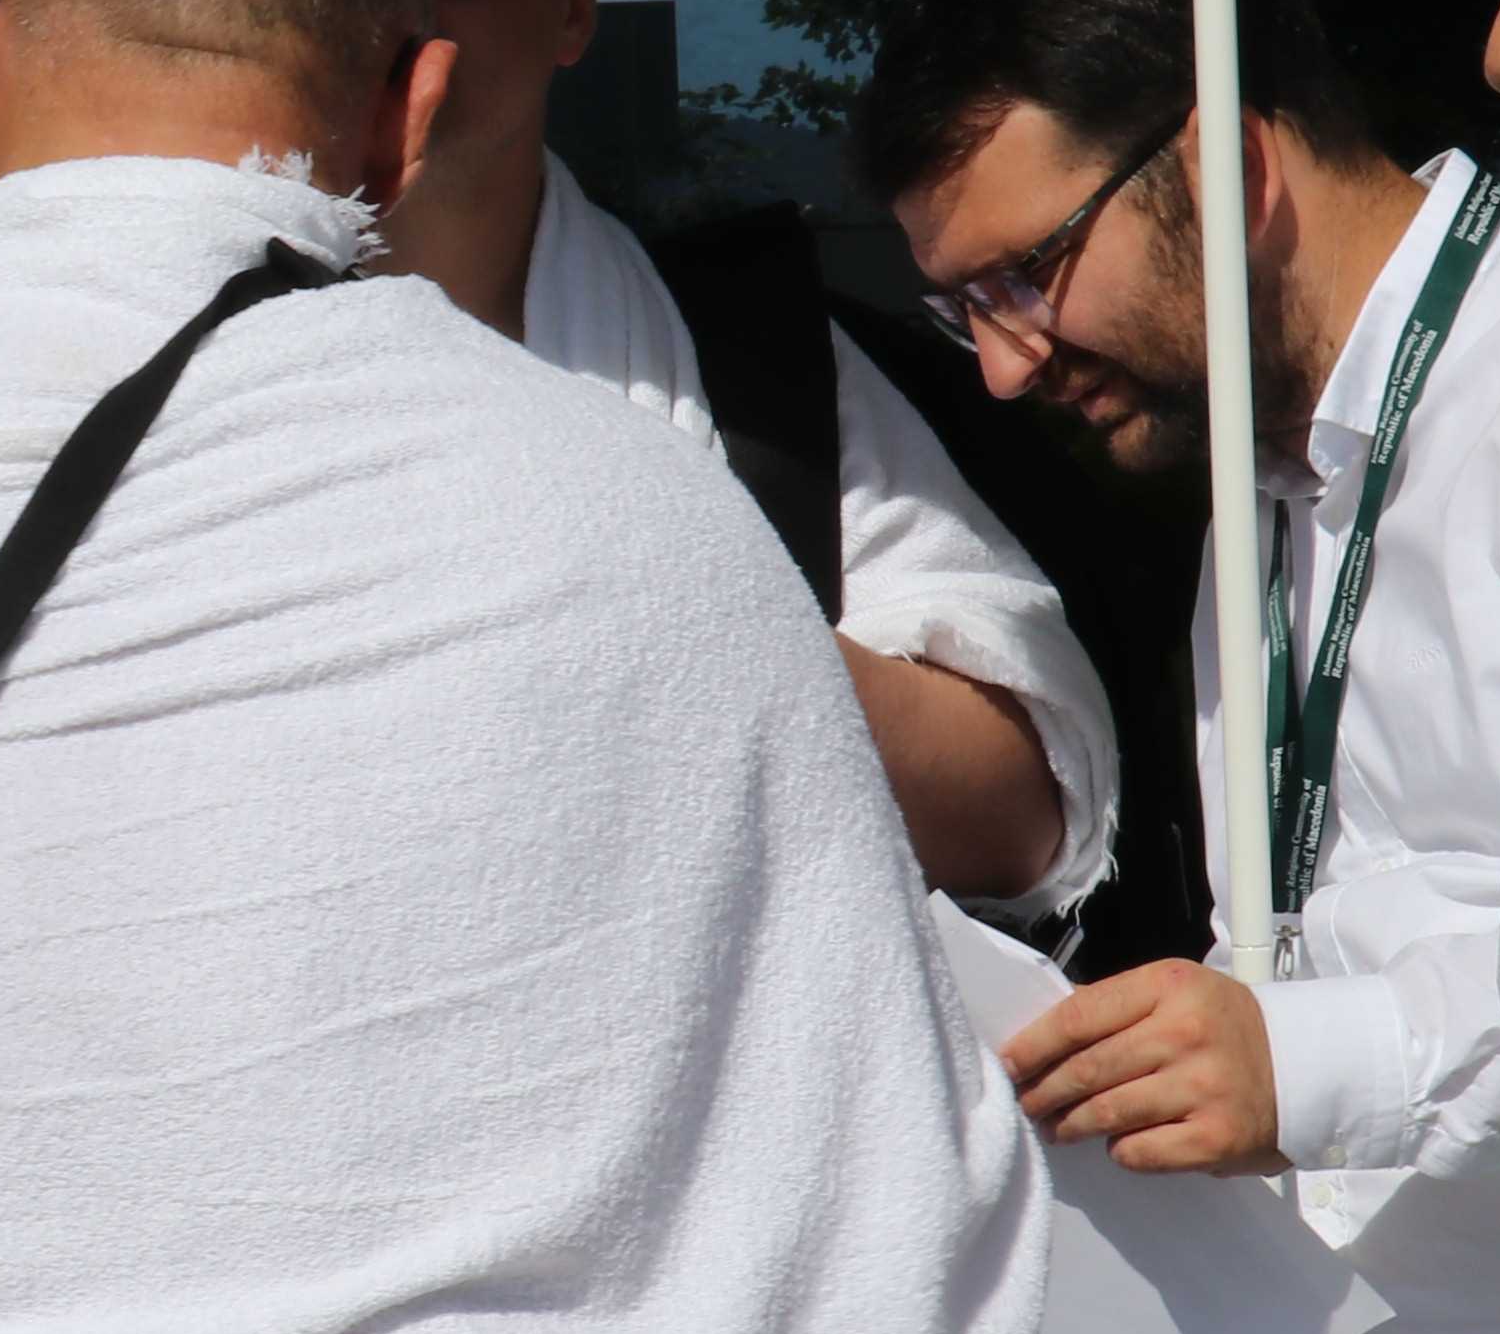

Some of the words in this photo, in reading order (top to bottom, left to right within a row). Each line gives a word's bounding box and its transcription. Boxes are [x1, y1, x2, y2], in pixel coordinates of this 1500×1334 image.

[1401, 329, 1438, 394] Macedonia
[1397, 391, 1409, 409] of
[1377, 410, 1403, 465] Republic
[1331, 622, 1354, 679] Republic
[1348, 535, 1371, 605] Macedonia
[1303, 783, 1328, 852] Macedonia
